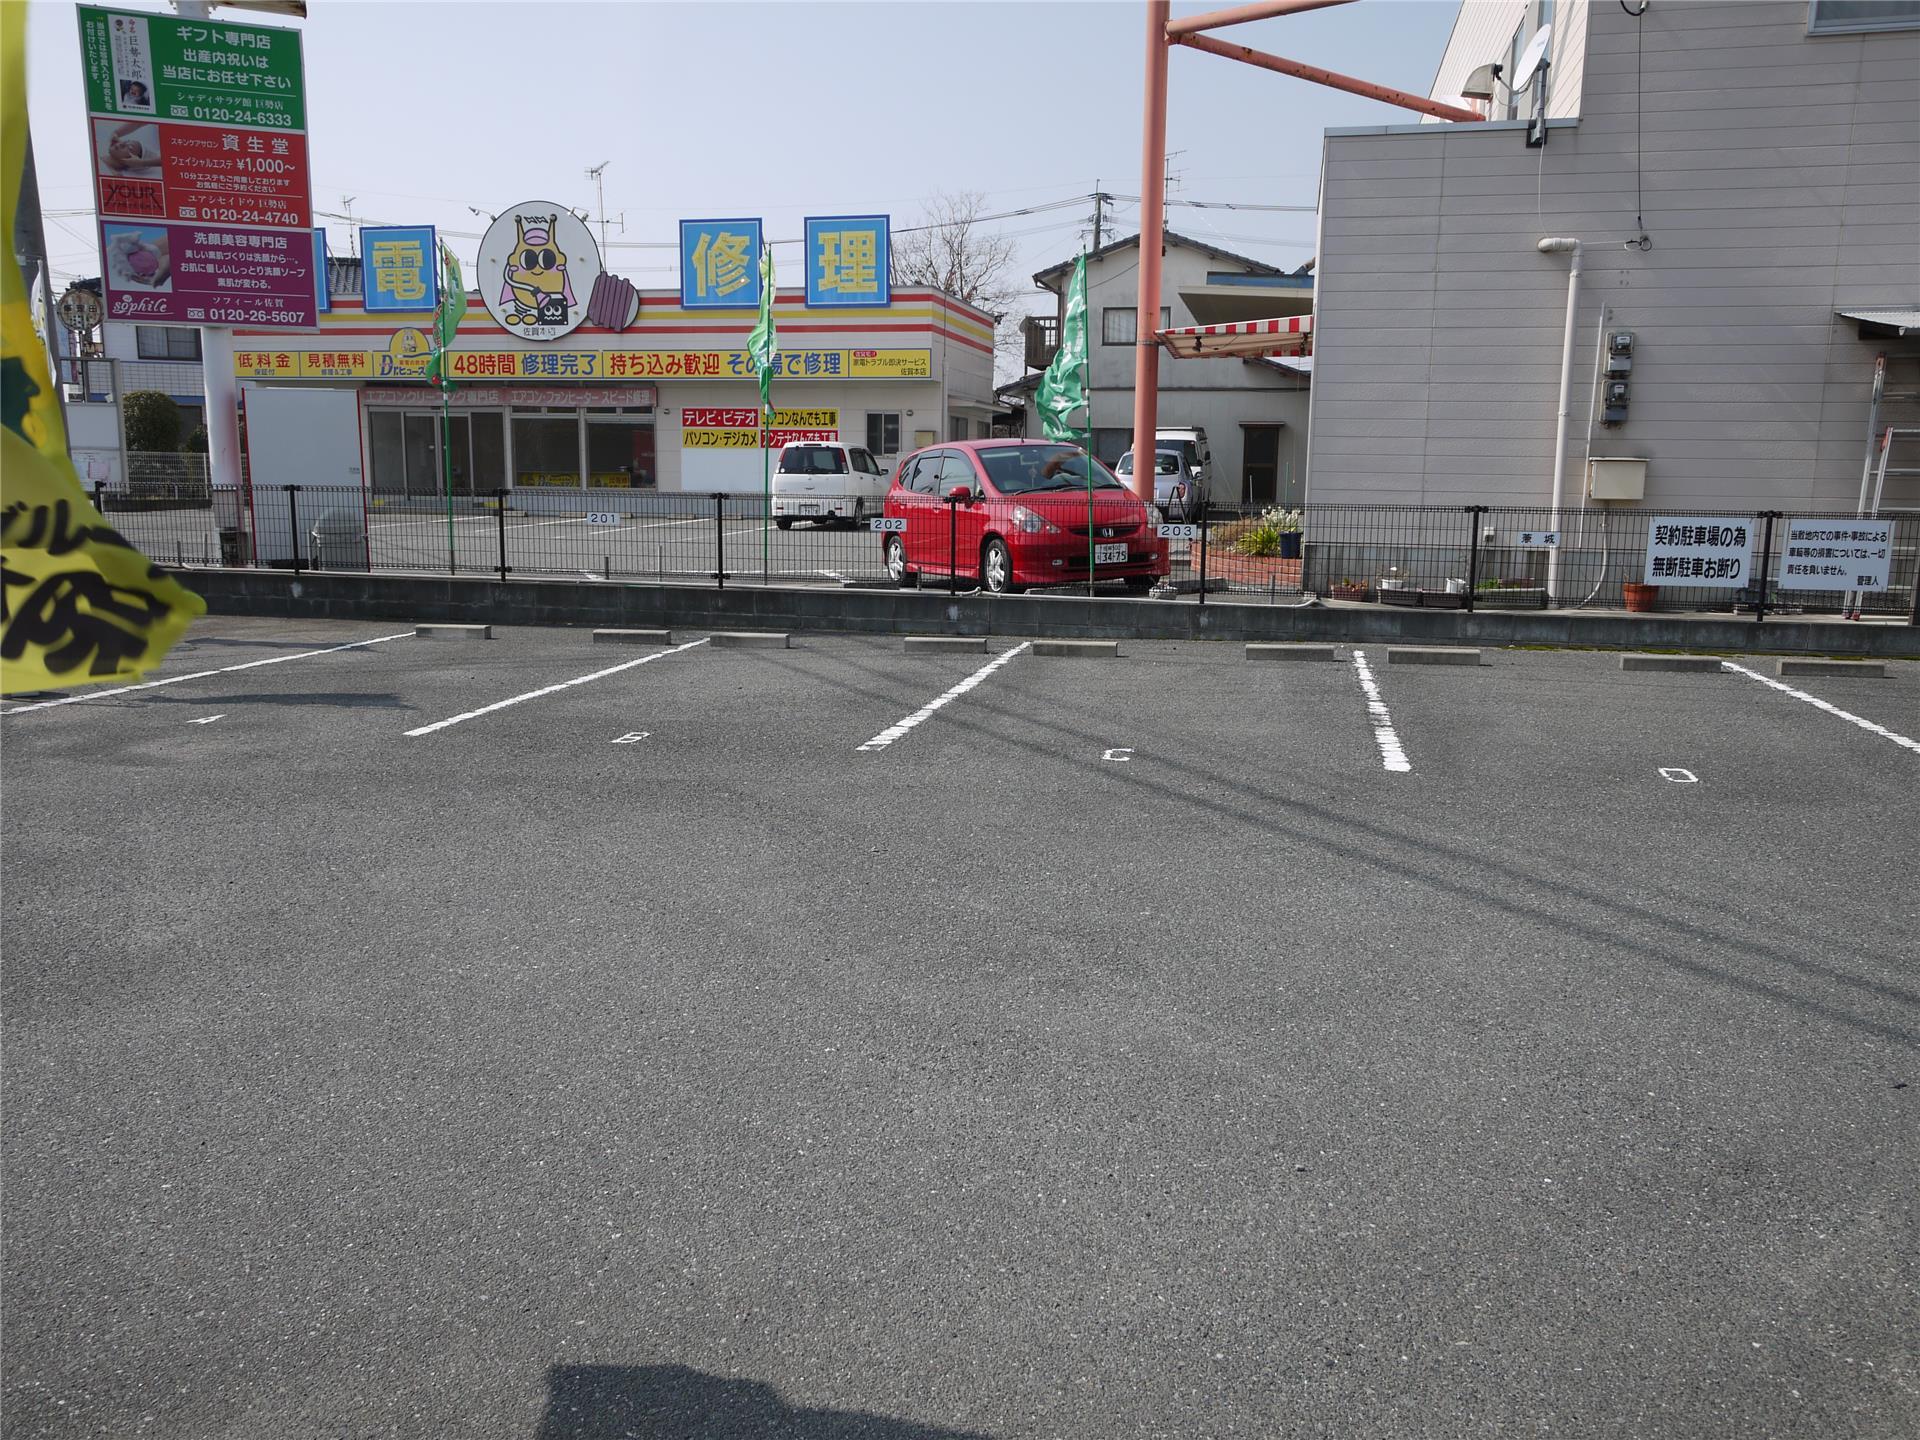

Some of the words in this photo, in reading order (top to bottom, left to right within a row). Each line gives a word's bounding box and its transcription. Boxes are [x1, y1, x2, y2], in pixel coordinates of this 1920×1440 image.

[177, 26, 271, 49] ギフト専門店
[183, 48, 269, 69] 出産内祝いは
[163, 64, 292, 88] 当店にお任せ下さい
[193, 106, 292, 126] 0120-24-6333
[171, 137, 219, 148] スキンケアサロン
[222, 133, 289, 155] 資生堂
[170, 155, 233, 169] フェイシャルエステ
[179, 171, 290, 186] 10分エステもご用意しております
[196, 181, 276, 193] お気軽にご予約ください
[188, 195, 255, 207] ユアシセイドウ
[202, 207, 299, 225] 0120-24-4740
[193, 231, 288, 249] 洗顔美容専門店
[180, 262, 306, 277] お肌に優しいしっとり洗顔ソープ
[691, 231, 750, 297] 修
[817, 230, 878, 294] 理
[371, 240, 426, 300] 電
[217, 277, 271, 289] 素肌が変わる。
[210, 308, 305, 323] 0120-26-5607
[238, 353, 291, 368] 低料金
[308, 353, 365, 368] 見積無料
[454, 353, 516, 376] 48時間
[521, 353, 597, 376] 修理完了
[610, 353, 720, 376] 持ち込み歓迎
[900, 367, 927, 376] 佐賀本店
[684, 410, 757, 426] テレビ・ビデオ
[684, 431, 757, 447] パソコン・デジカメ
[591, 513, 615, 524] 201
[874, 519, 903, 531] 202
[1161, 525, 1192, 538] 203
[1655, 524, 1747, 548] 契約駐車場の為
[1652, 556, 1742, 580] 無断駐車お断り
[1787, 564, 1848, 576] 責任を負いません。
[1857, 575, 1879, 586] 管理人
[610, 731, 650, 743] B
[1102, 748, 1134, 761] C
